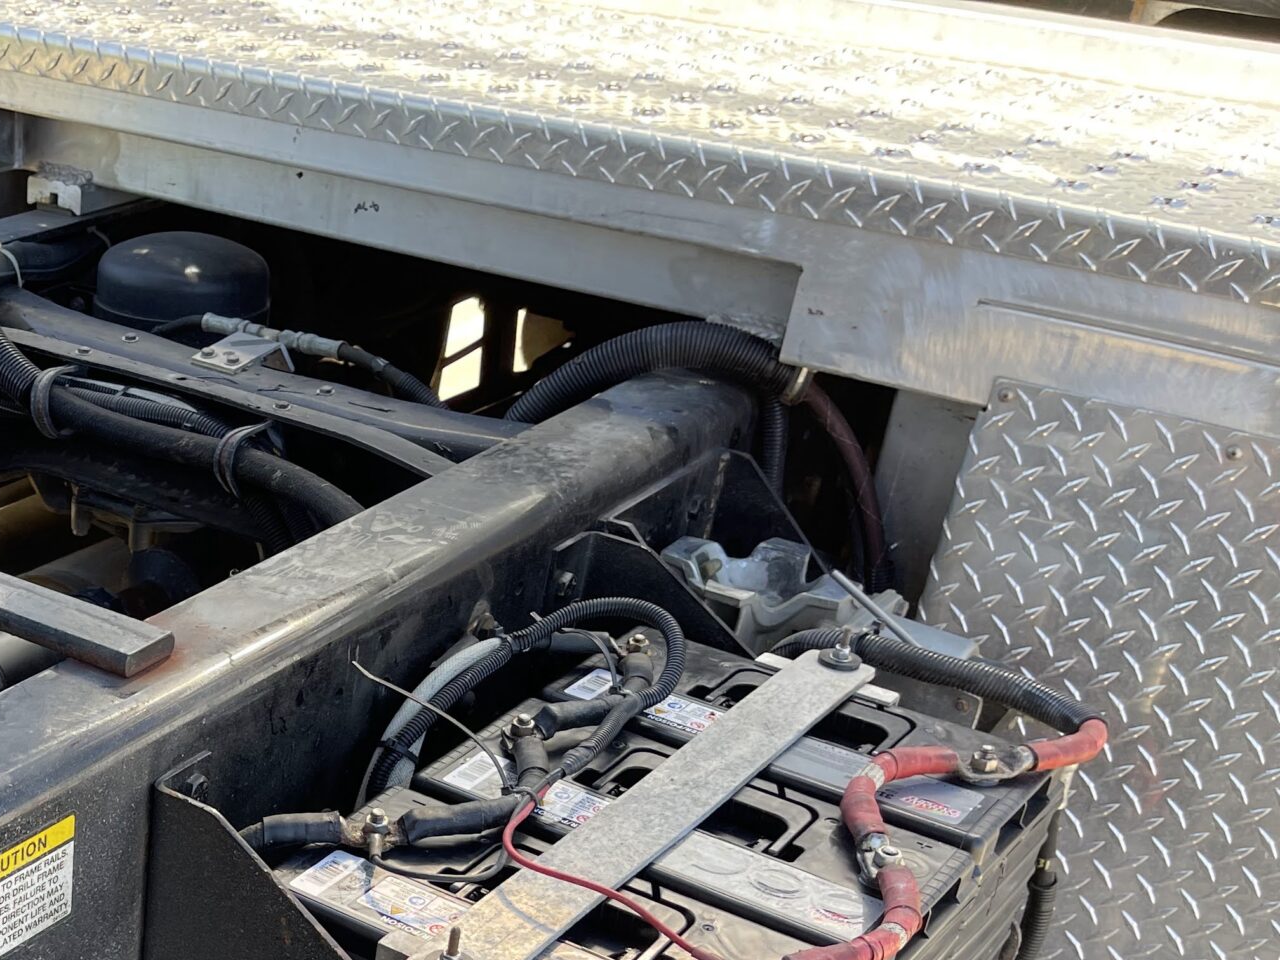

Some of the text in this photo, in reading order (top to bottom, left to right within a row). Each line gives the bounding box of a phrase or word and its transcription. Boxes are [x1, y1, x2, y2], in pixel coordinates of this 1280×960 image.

[0, 892, 11, 905] OR
[12, 879, 36, 897] DRILL
[37, 860, 64, 882] FRAME
[1, 880, 12, 892] TO
[15, 863, 42, 887] FRAME
[13, 882, 46, 909] FAILURE
[48, 875, 59, 887] TO
[2, 894, 45, 925] DIRECTION
[47, 882, 64, 899] MAY
[31, 902, 47, 918] LIFE
[49, 893, 65, 910] AND
